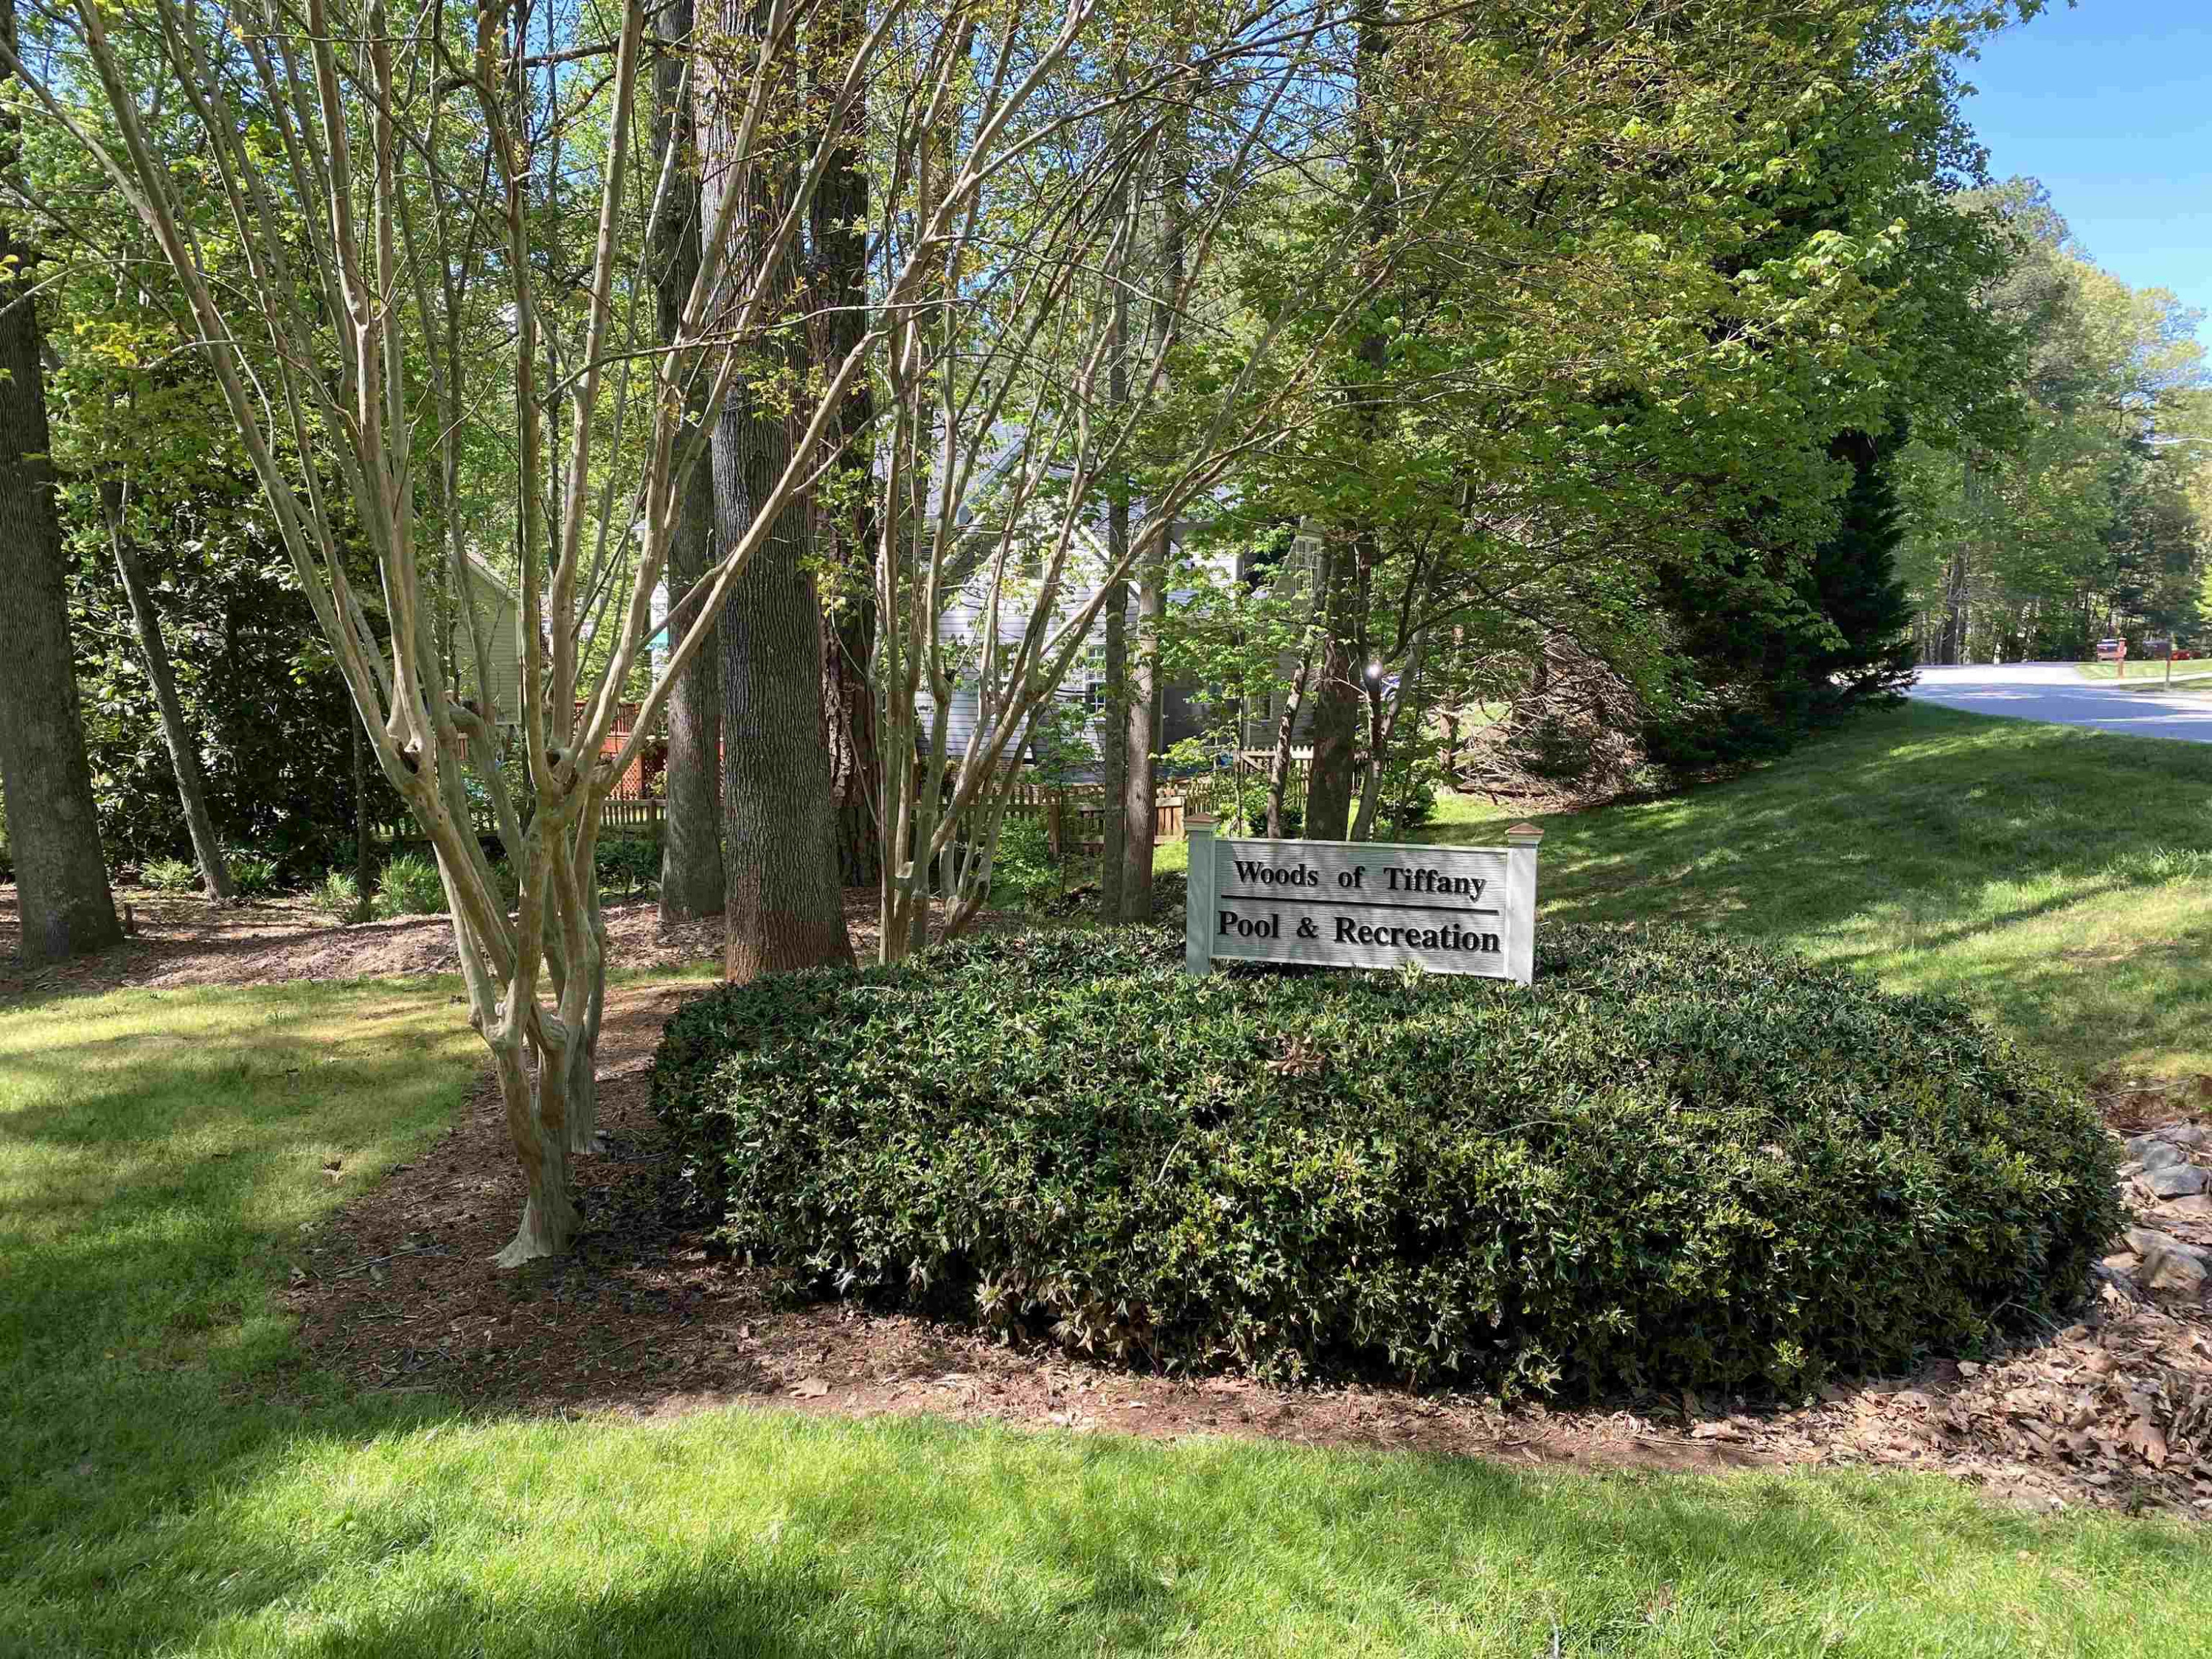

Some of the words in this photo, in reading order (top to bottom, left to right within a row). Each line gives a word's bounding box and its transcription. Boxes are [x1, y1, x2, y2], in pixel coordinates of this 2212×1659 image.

[1235, 860, 1318, 886] Woods
[1338, 866, 1365, 888] of
[1384, 866, 1486, 902] Tiffany
[1217, 911, 1279, 938] Pool
[1296, 917, 1318, 939] &
[1334, 916, 1501, 953] Recreation
